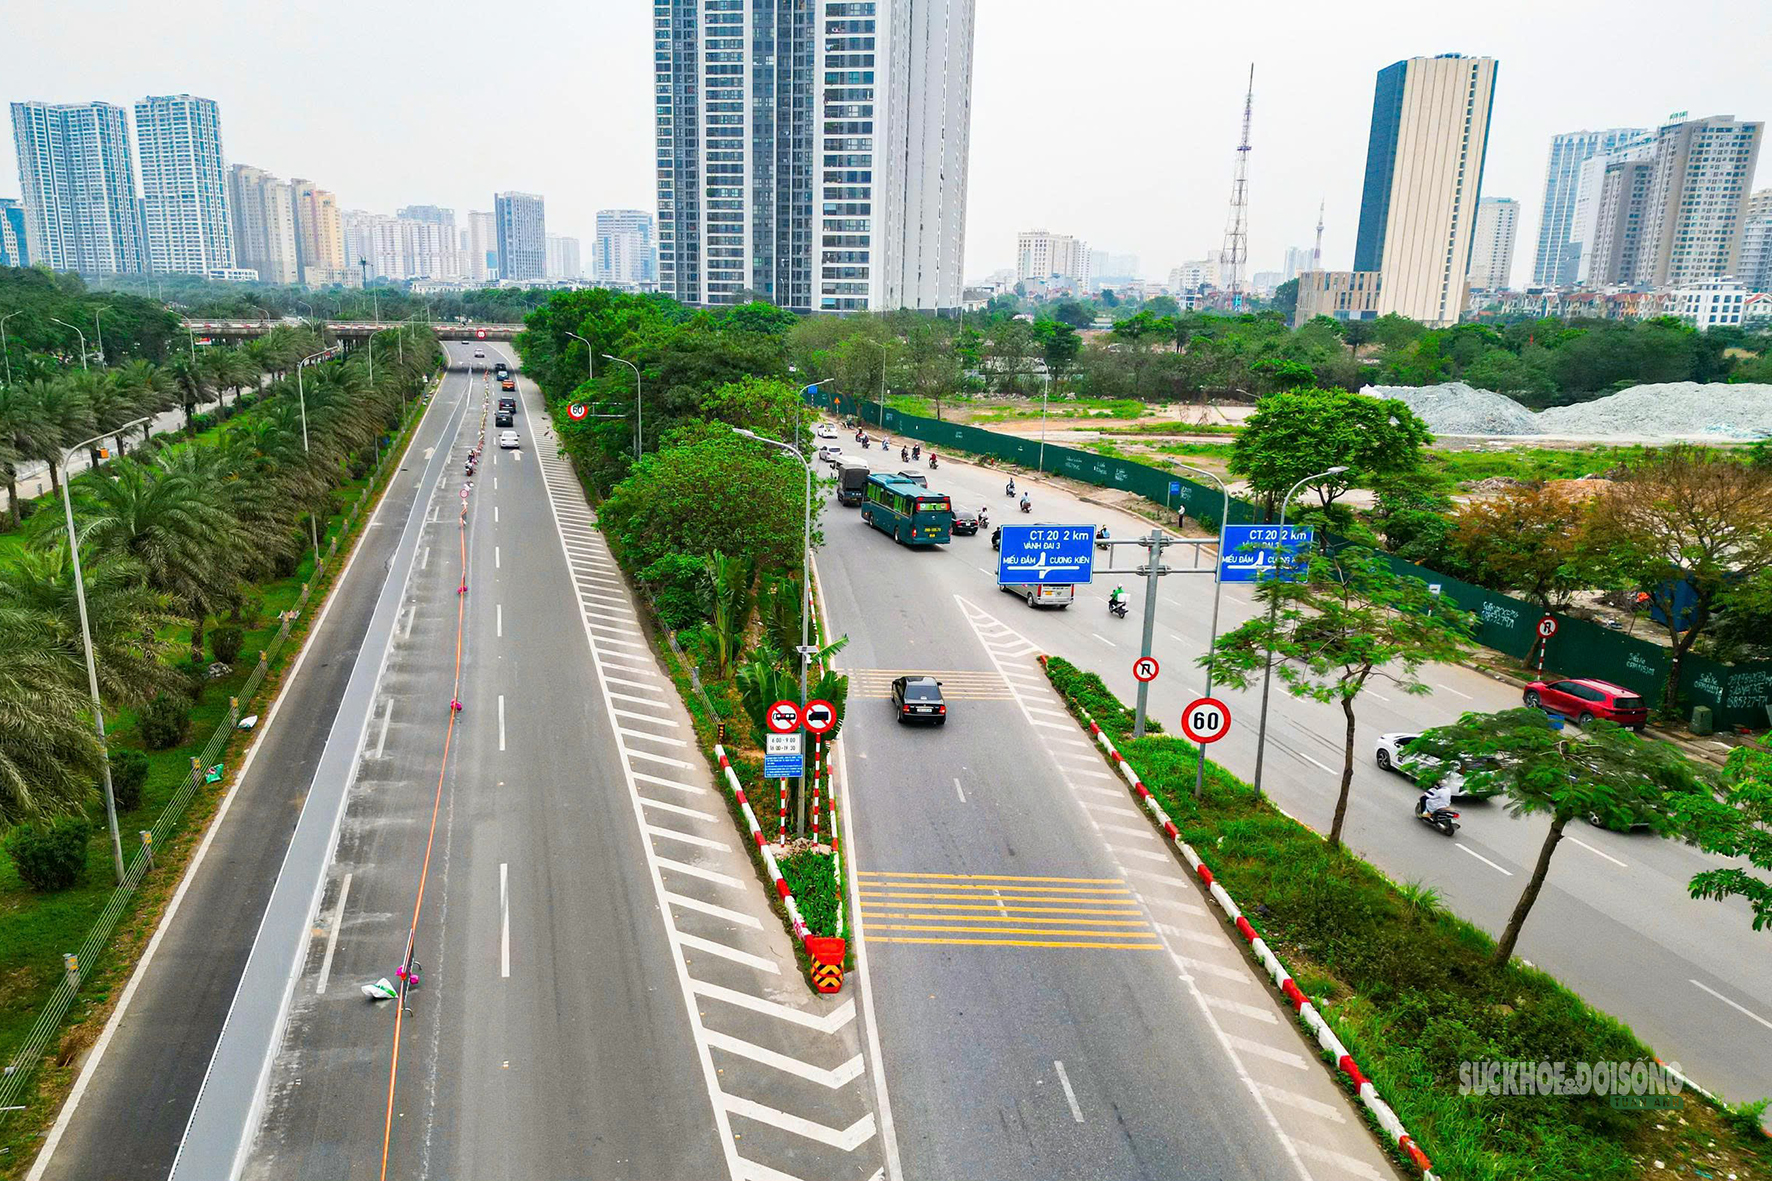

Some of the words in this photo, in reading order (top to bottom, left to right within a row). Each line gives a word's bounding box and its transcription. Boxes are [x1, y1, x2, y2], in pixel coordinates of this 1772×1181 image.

[572, 405, 583, 414] 60
[1063, 530, 1070, 541] 2
[1072, 530, 1089, 541] km
[1281, 530, 1289, 540] 2
[1290, 530, 1307, 540] km
[1056, 542, 1061, 550] 3
[1193, 711, 1219, 731] 60
